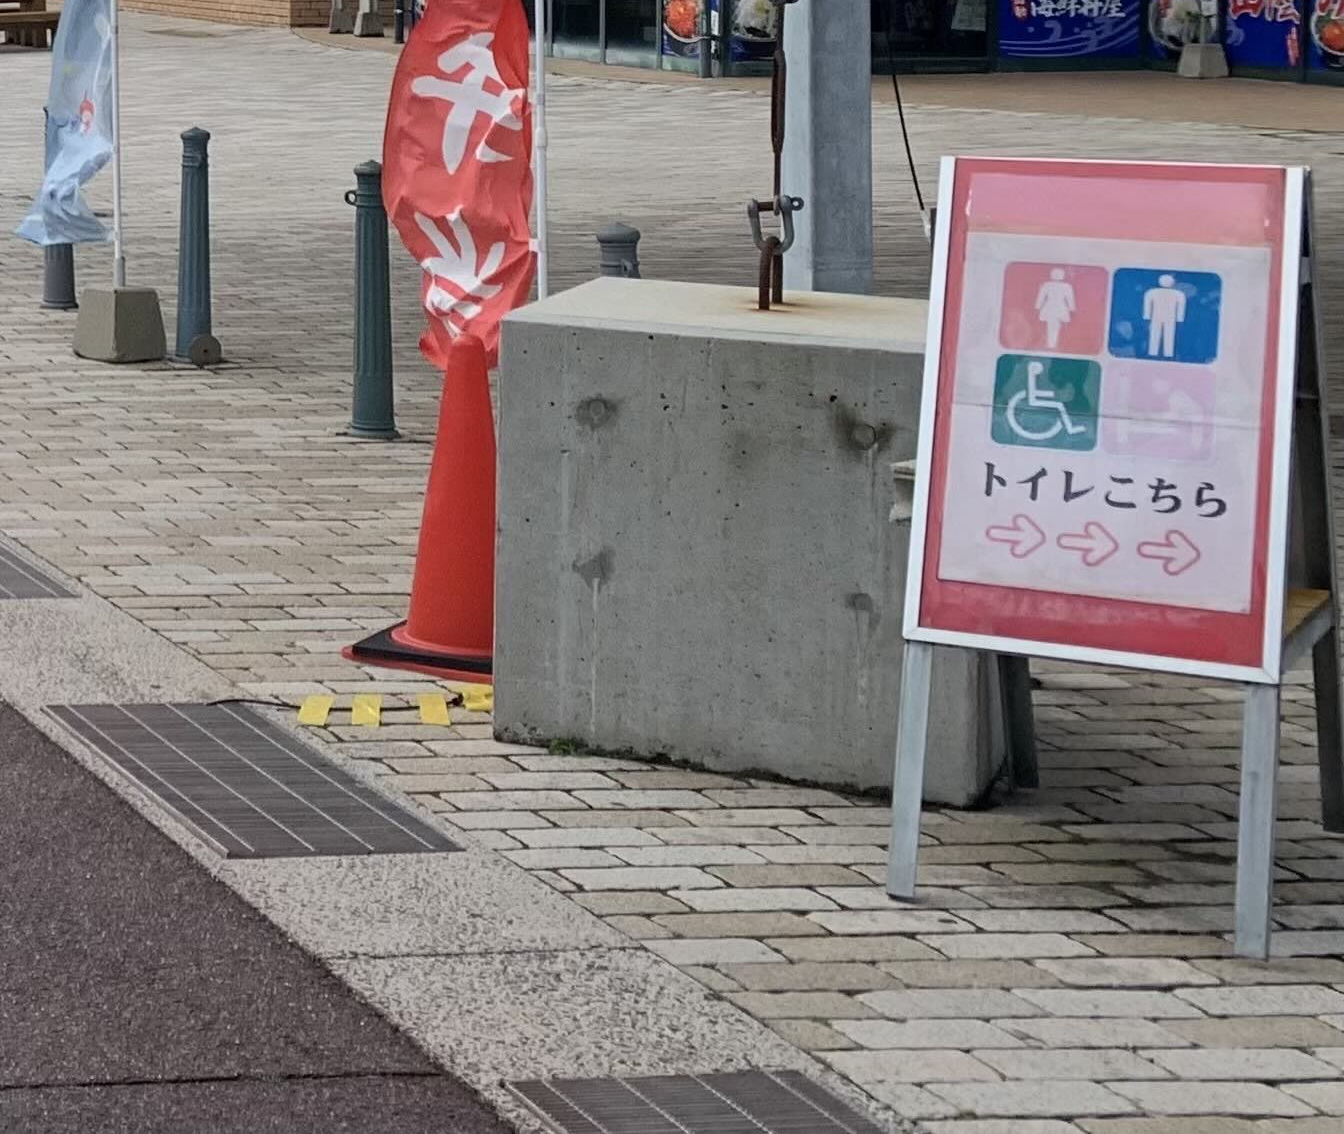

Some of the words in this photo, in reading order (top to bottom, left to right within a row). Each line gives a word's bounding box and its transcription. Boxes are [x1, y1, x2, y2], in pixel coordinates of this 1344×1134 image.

[983, 461, 1228, 518] トイレこちら
